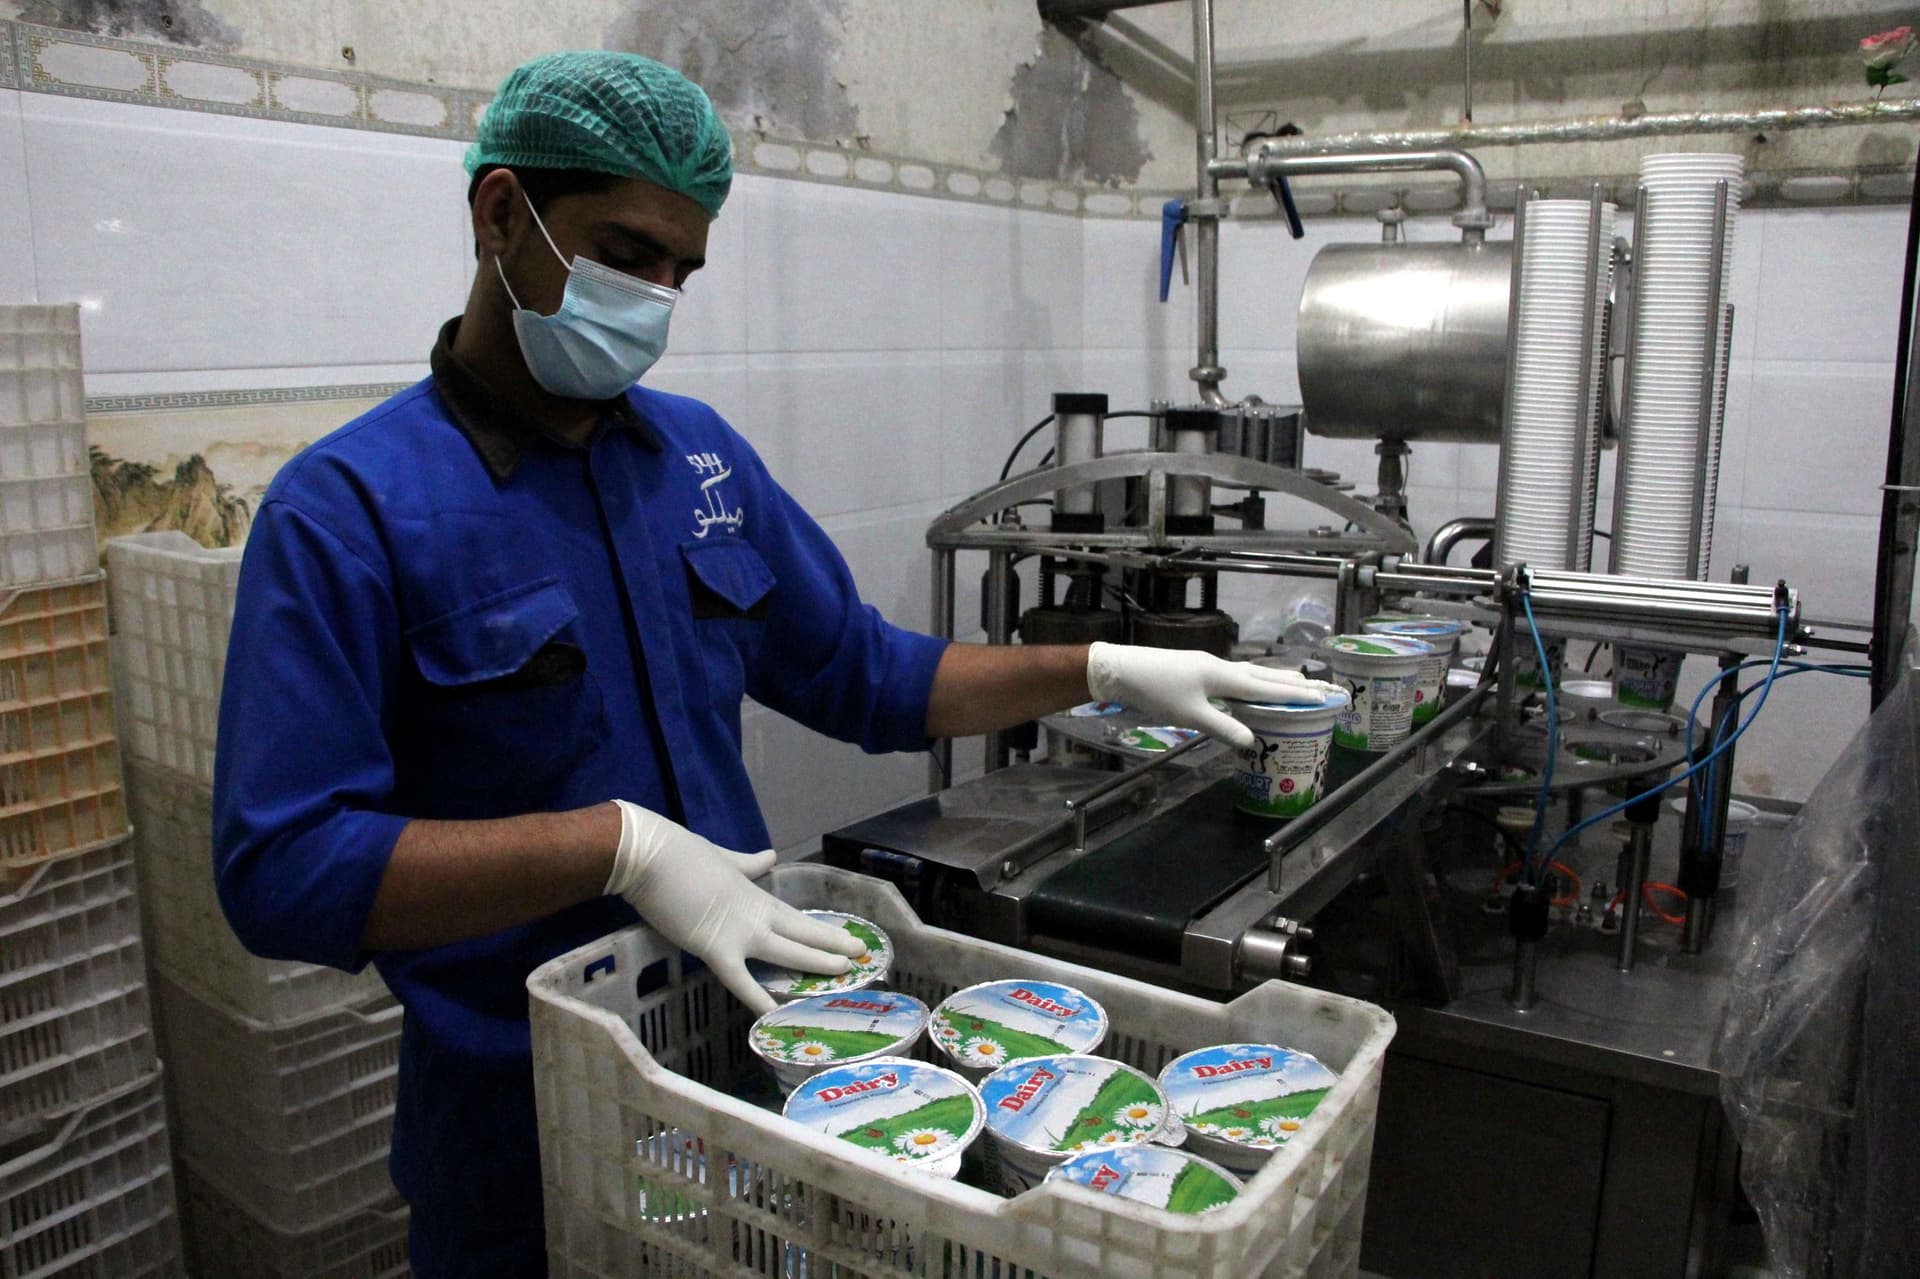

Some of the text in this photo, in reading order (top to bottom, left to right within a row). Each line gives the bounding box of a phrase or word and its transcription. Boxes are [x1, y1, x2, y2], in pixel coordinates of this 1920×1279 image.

[824, 999, 896, 1014] Dairy
[1008, 988, 1079, 1017] Dairy
[1192, 1056, 1272, 1079] Dairy
[816, 1072, 898, 1103] Dairy
[999, 1066, 1055, 1112] Dairy
